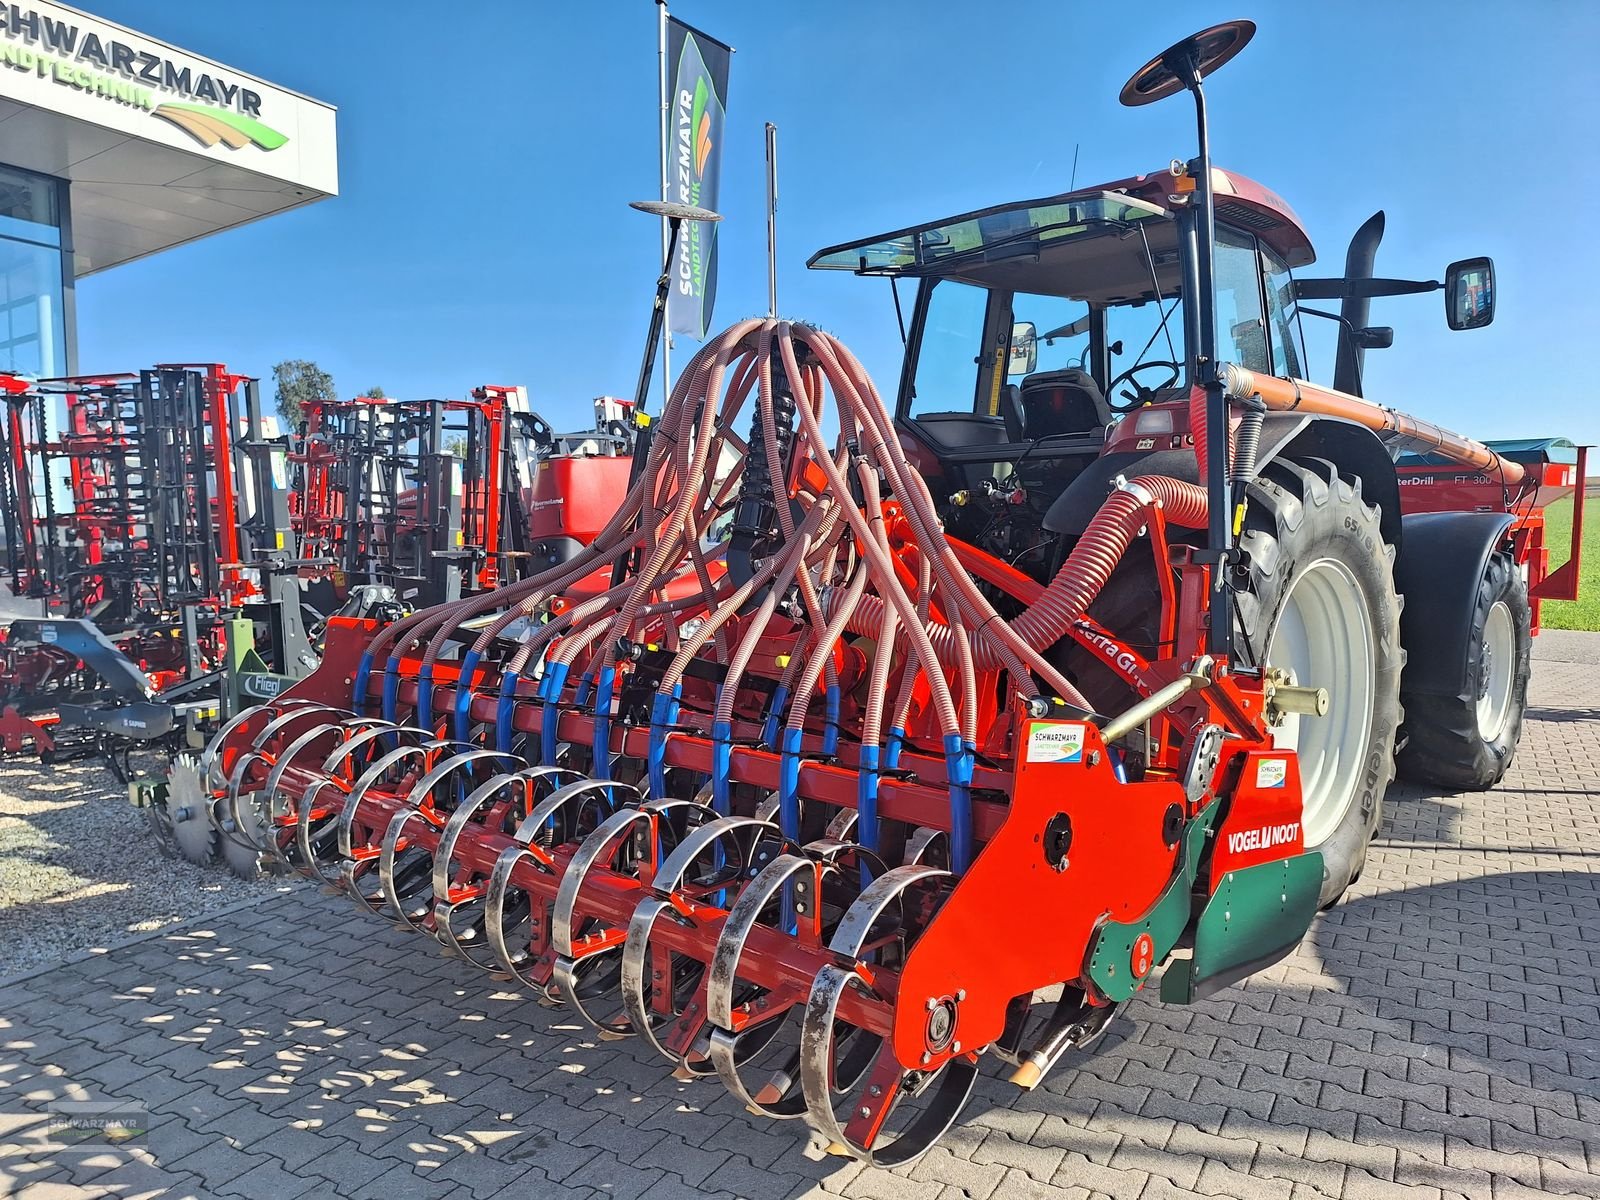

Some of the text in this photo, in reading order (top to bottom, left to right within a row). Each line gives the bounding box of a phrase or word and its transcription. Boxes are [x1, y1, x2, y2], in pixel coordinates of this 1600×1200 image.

[678, 89, 694, 297] SCHWRZMAYR
[691, 180, 702, 297] LANDTECNIK
[1454, 475, 1492, 485] FT 300
[255, 675, 281, 696] Fliegl
[1035, 732, 1077, 742] SCHWARZMAYR
[1228, 822, 1300, 854] VOGEL NOOT
